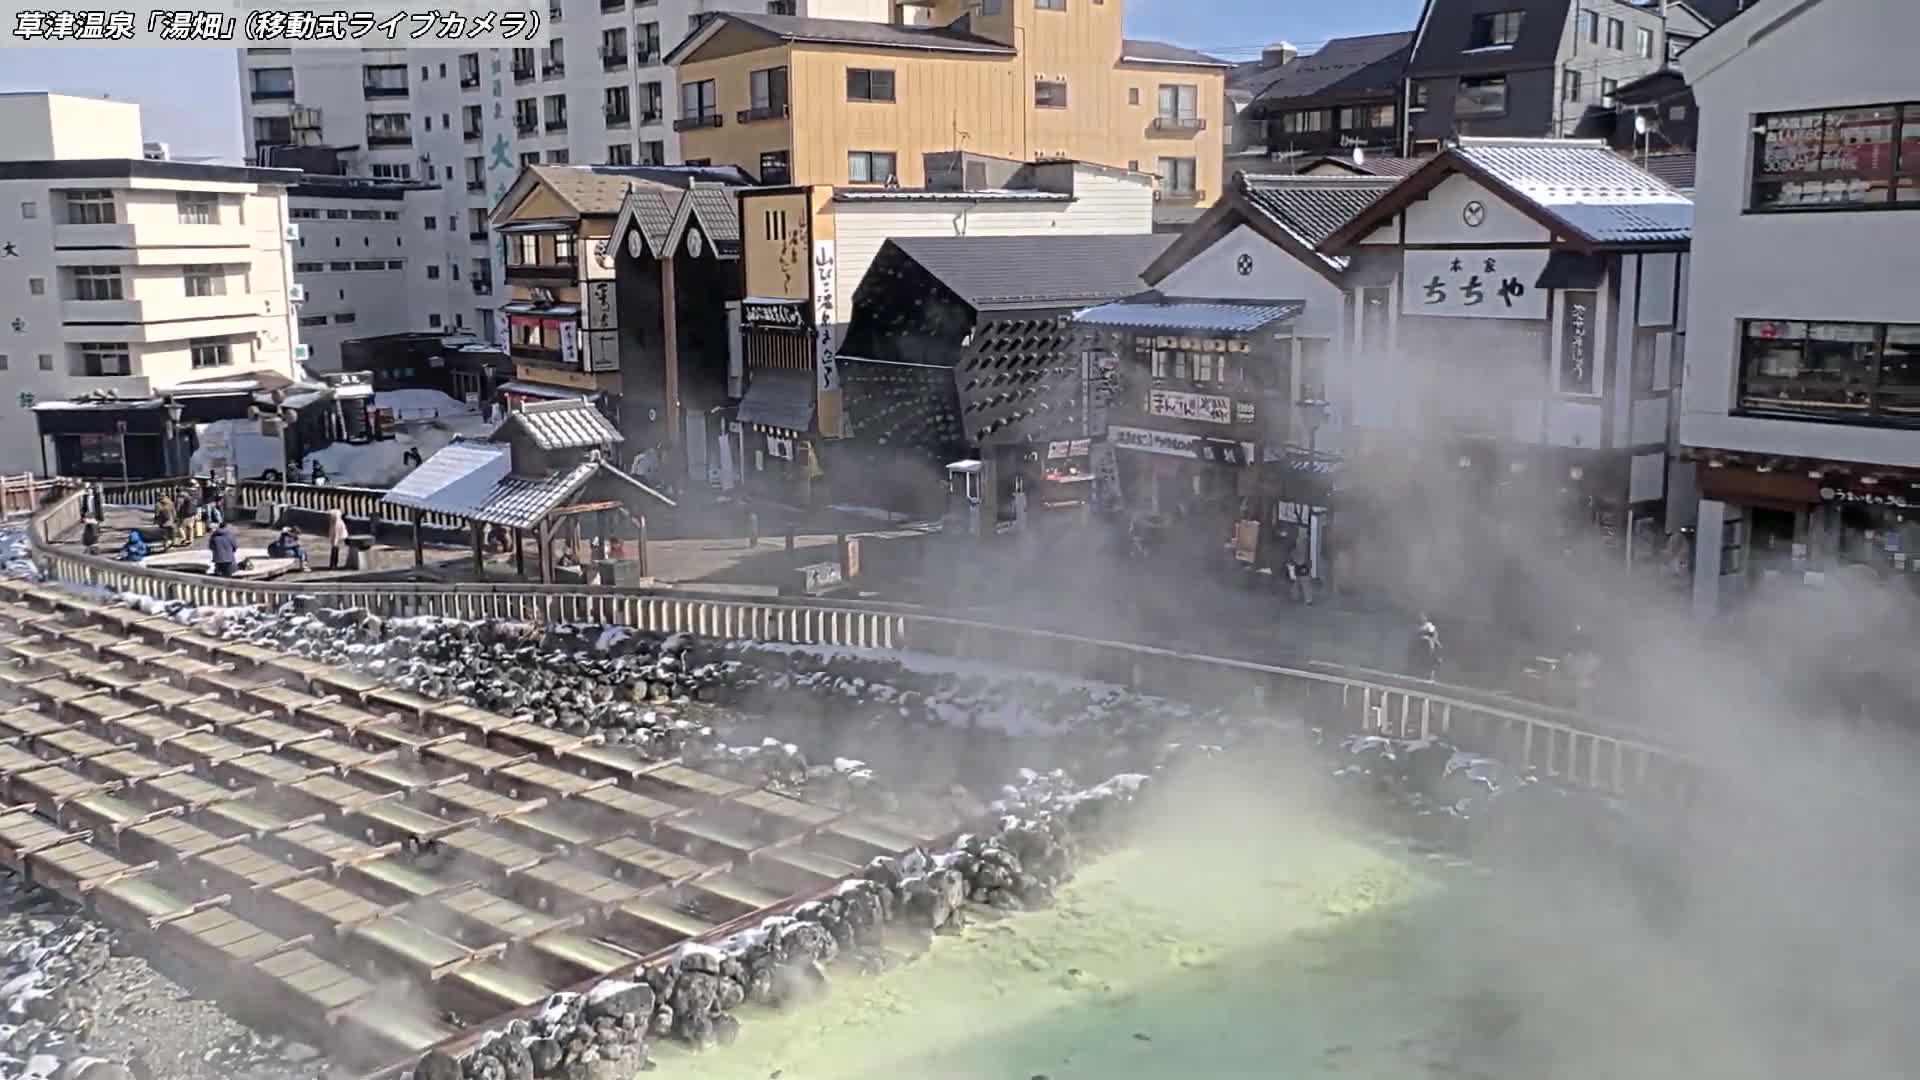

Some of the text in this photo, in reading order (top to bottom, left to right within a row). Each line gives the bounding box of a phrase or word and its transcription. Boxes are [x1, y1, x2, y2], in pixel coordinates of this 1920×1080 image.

[1450, 256, 1497, 273] 本家
[1423, 275, 1525, 308] ちちや
